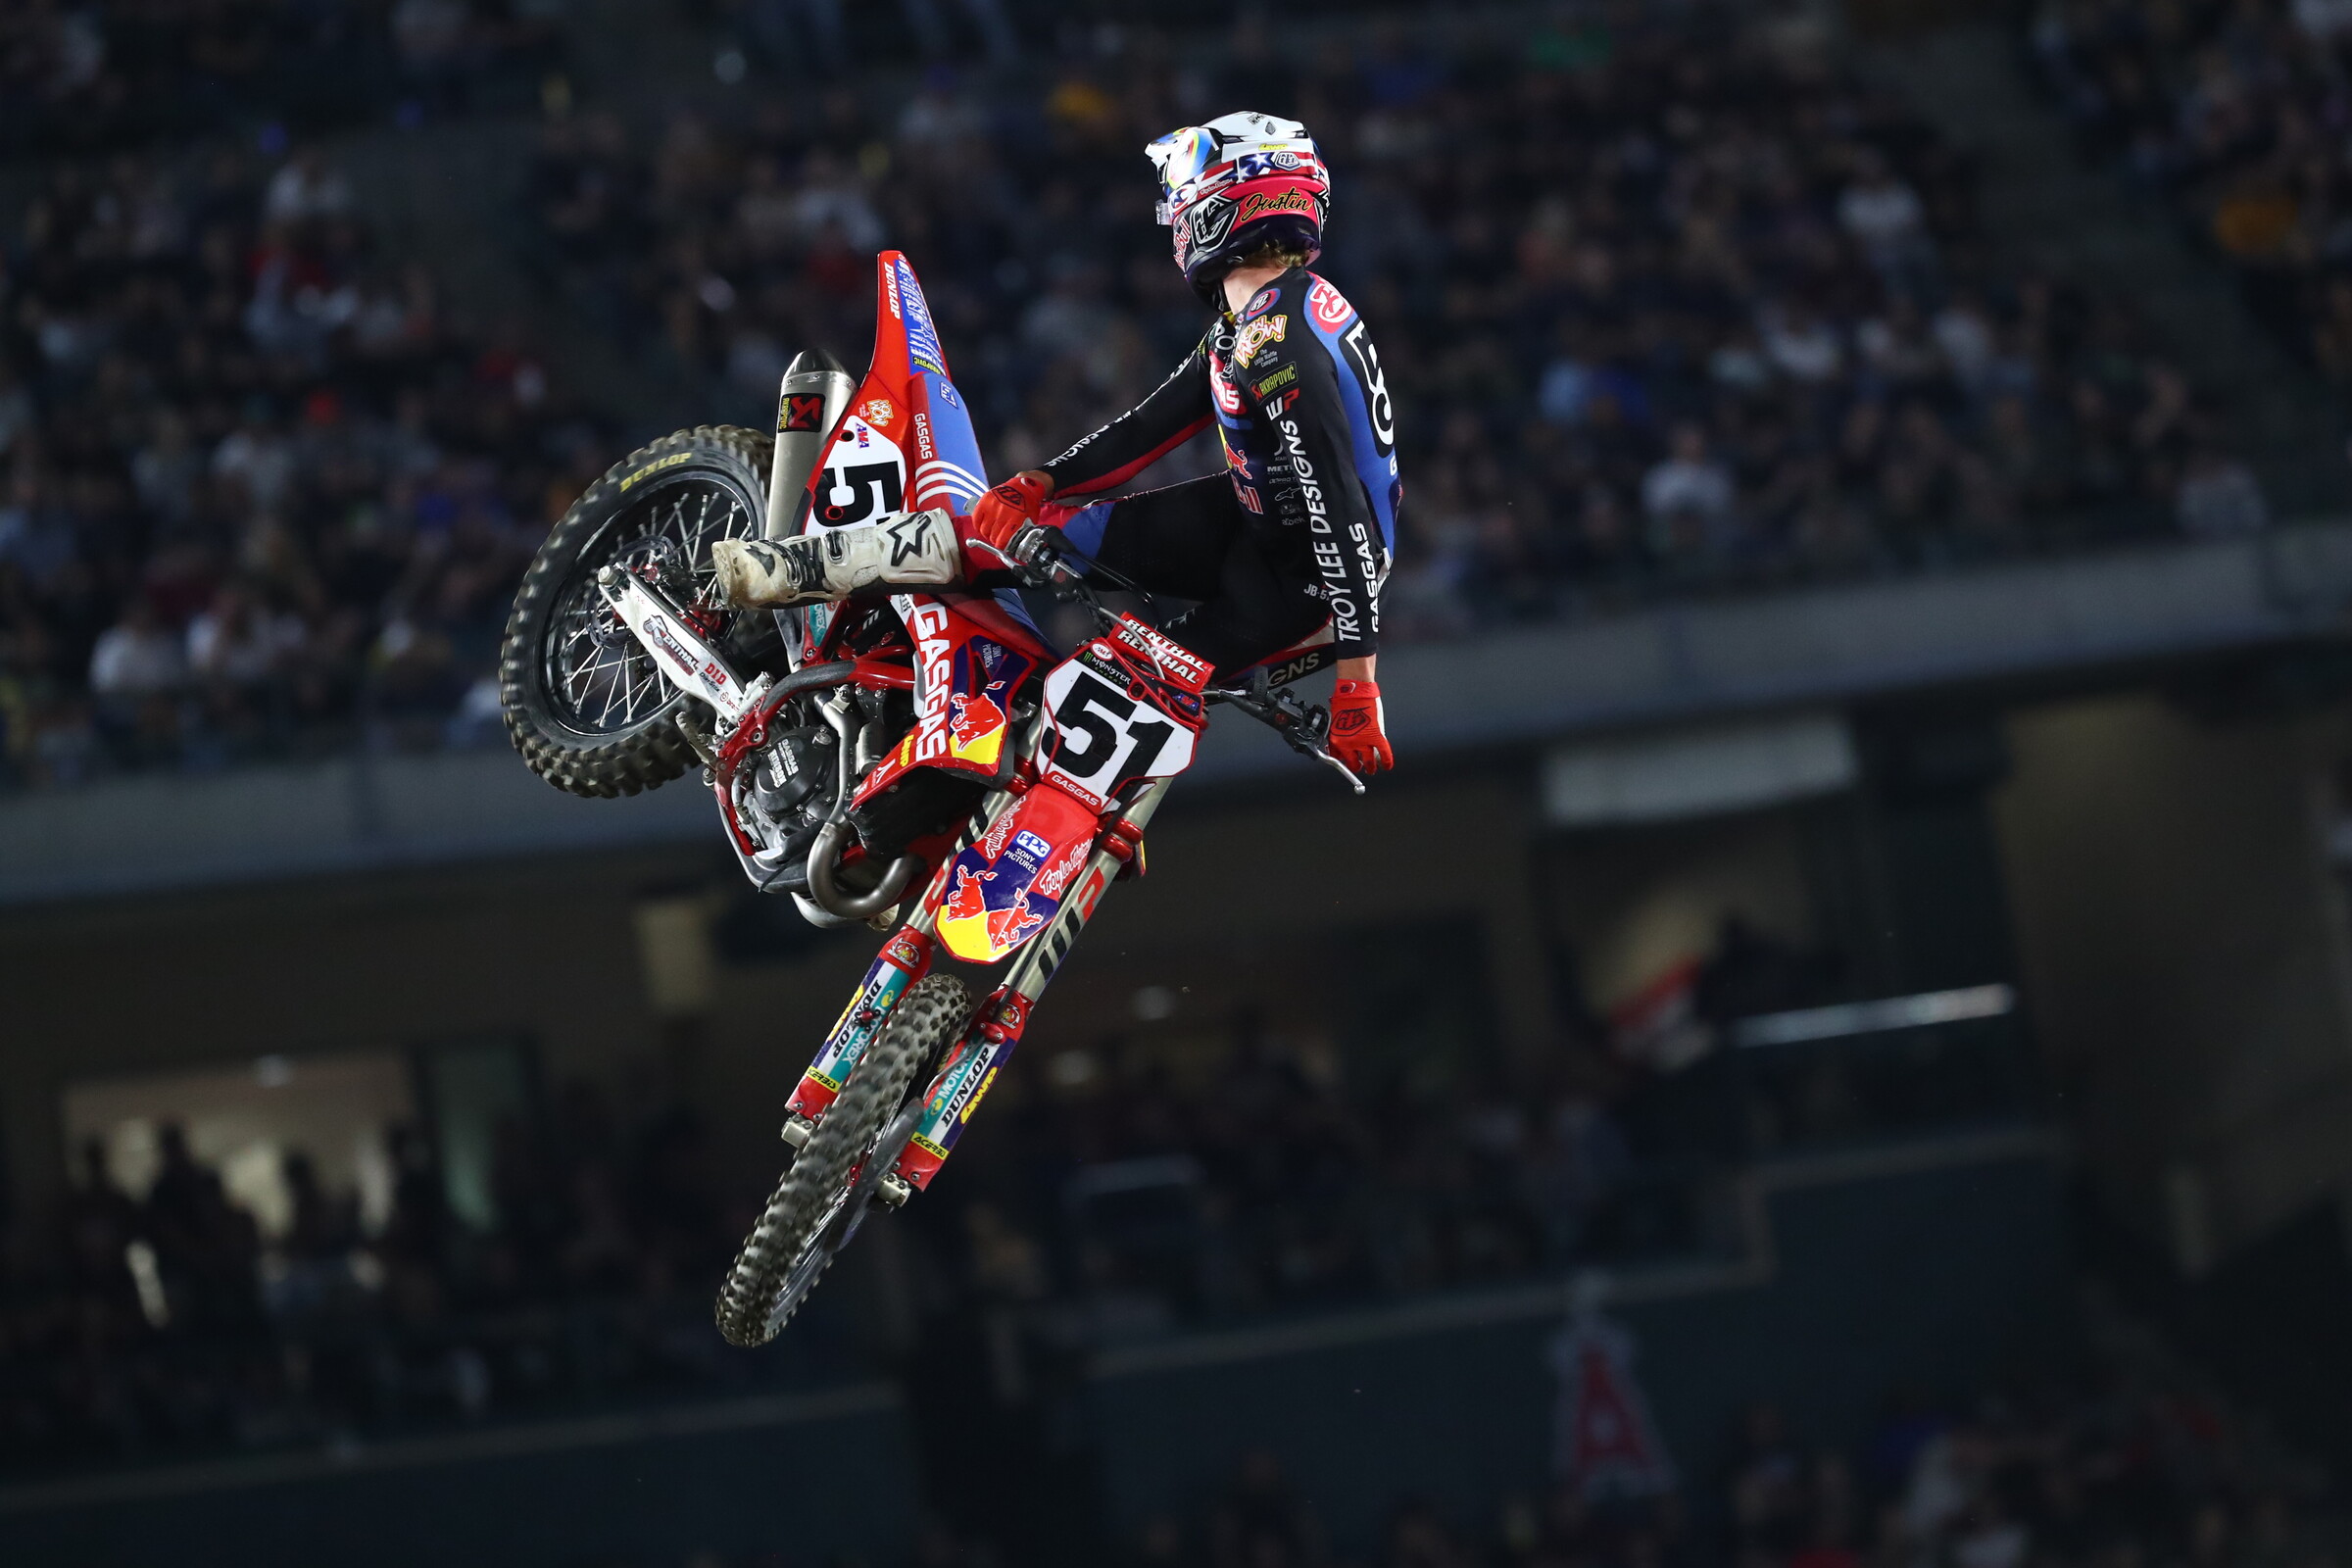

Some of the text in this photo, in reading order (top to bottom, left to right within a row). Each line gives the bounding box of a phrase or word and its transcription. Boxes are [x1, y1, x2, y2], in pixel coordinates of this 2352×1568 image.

[1241, 186, 1313, 222] Justin
[884, 262, 901, 319] DUNLOP
[856, 422, 870, 449] AMA
[914, 413, 932, 460] GASGAS
[620, 452, 692, 493] DUNLOP
[813, 461, 901, 528] 5
[1280, 419, 1332, 535] DESIGNS
[1313, 541, 1348, 579] LEE
[1348, 522, 1380, 633] GASGAS
[1325, 581, 1361, 642] TROY
[1117, 630, 1200, 684] RENTHAL
[1126, 618, 1208, 672] RENTHAL
[705, 662, 727, 685] DID
[913, 602, 951, 762] GASGAS
[1092, 657, 1132, 685] MONSTER
[1172, 693, 1200, 711] AMA
[1041, 671, 1175, 803] 51
[1052, 774, 1100, 807] GASGAS
[1004, 851, 1038, 874] PICTURES
[1015, 848, 1036, 862] SONY
[1018, 832, 1049, 855] PPG
[941, 1047, 990, 1127] DUNLOP
